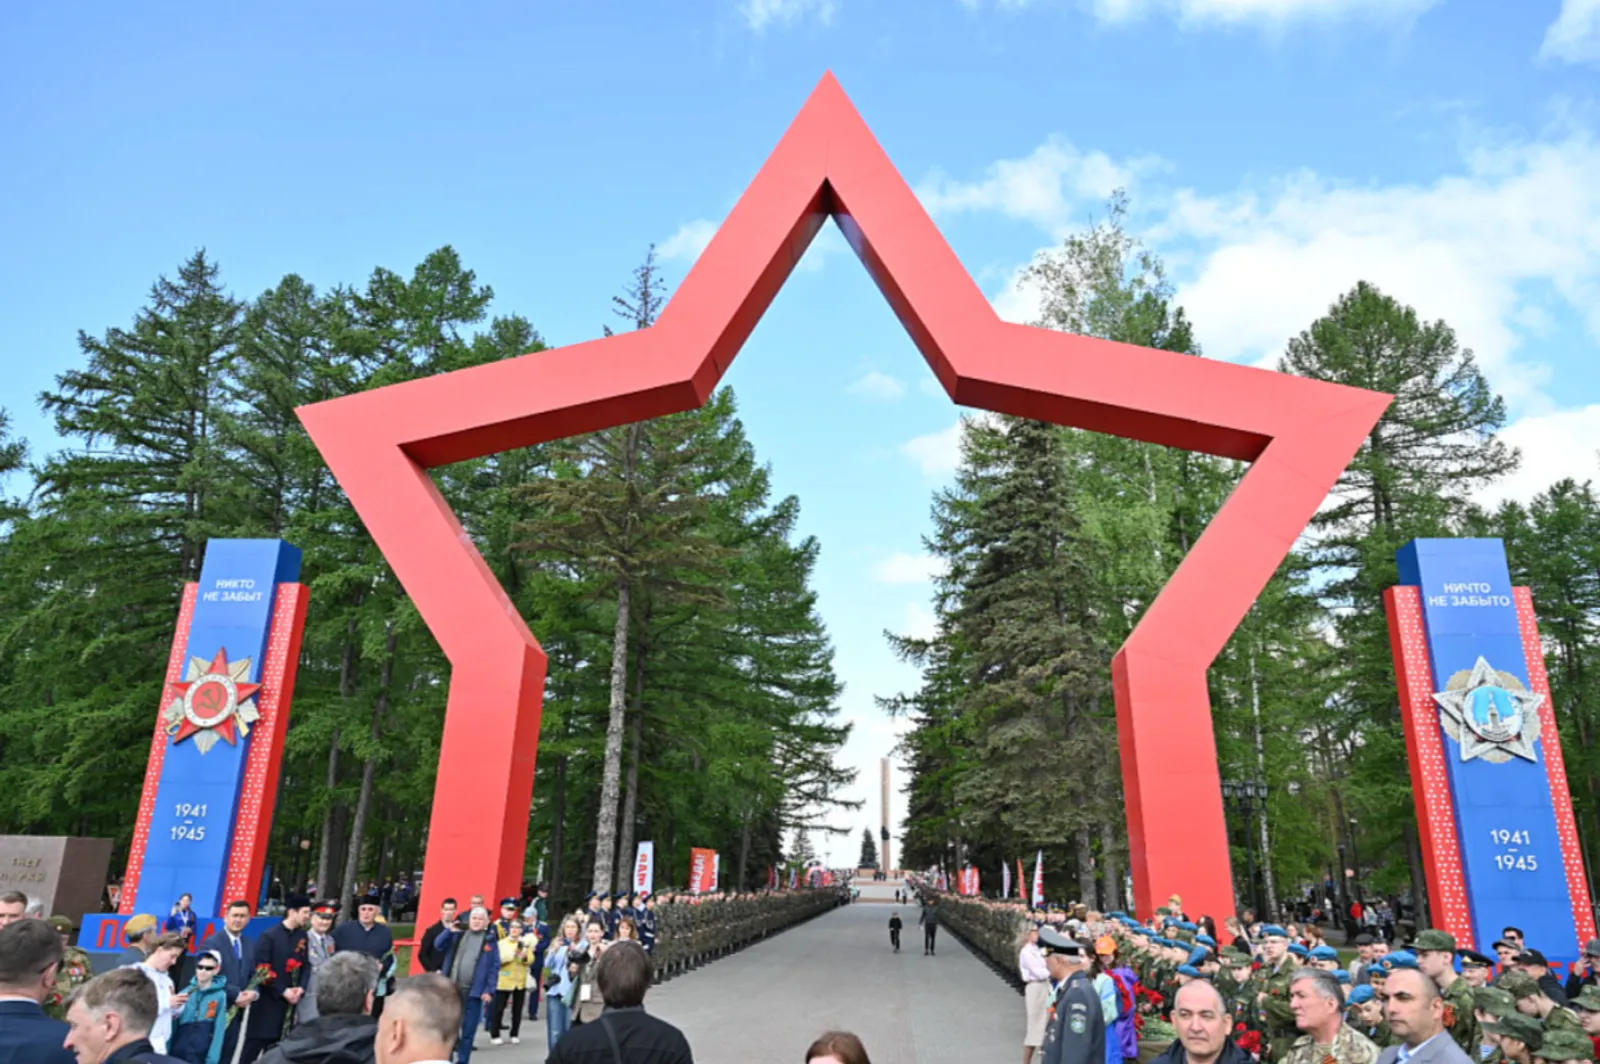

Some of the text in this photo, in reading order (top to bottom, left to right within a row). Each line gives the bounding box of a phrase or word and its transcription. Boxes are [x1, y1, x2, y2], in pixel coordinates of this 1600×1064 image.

[215, 579, 256, 589] НИКТО
[1443, 582, 1491, 594] НИЧТО
[203, 591, 263, 602] НЕ ЗАБЫТ
[1428, 595, 1510, 607] НЕ ЗАБЫТО
[175, 803, 208, 817] 1941
[170, 826, 206, 841] 1945
[1490, 829, 1531, 845] 1941
[1495, 855, 1538, 871] 1945
